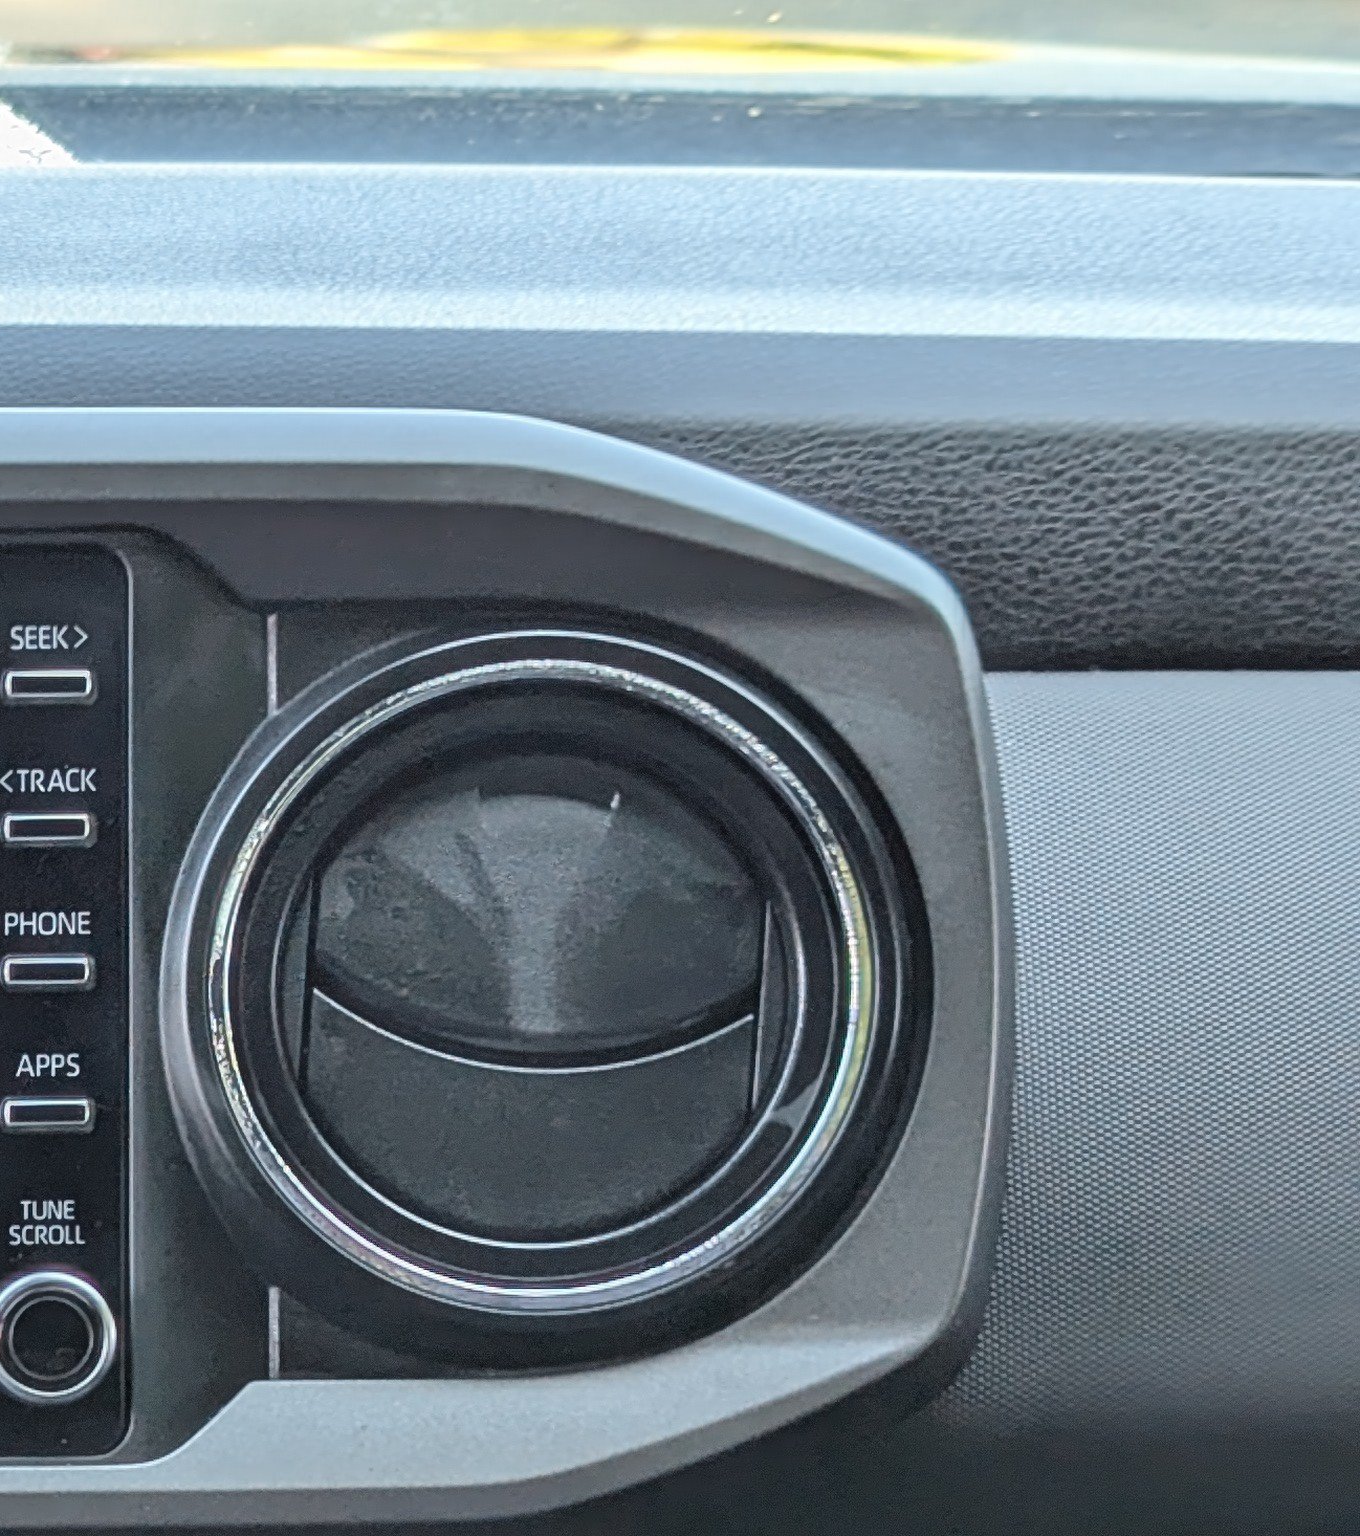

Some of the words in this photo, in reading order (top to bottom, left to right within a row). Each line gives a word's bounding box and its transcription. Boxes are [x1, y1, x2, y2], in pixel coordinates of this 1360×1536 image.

[4, 911, 91, 936] PHONE
[15, 1053, 80, 1077] APPS
[20, 1200, 75, 1221] TUNE
[8, 1225, 85, 1246] SCROLL
